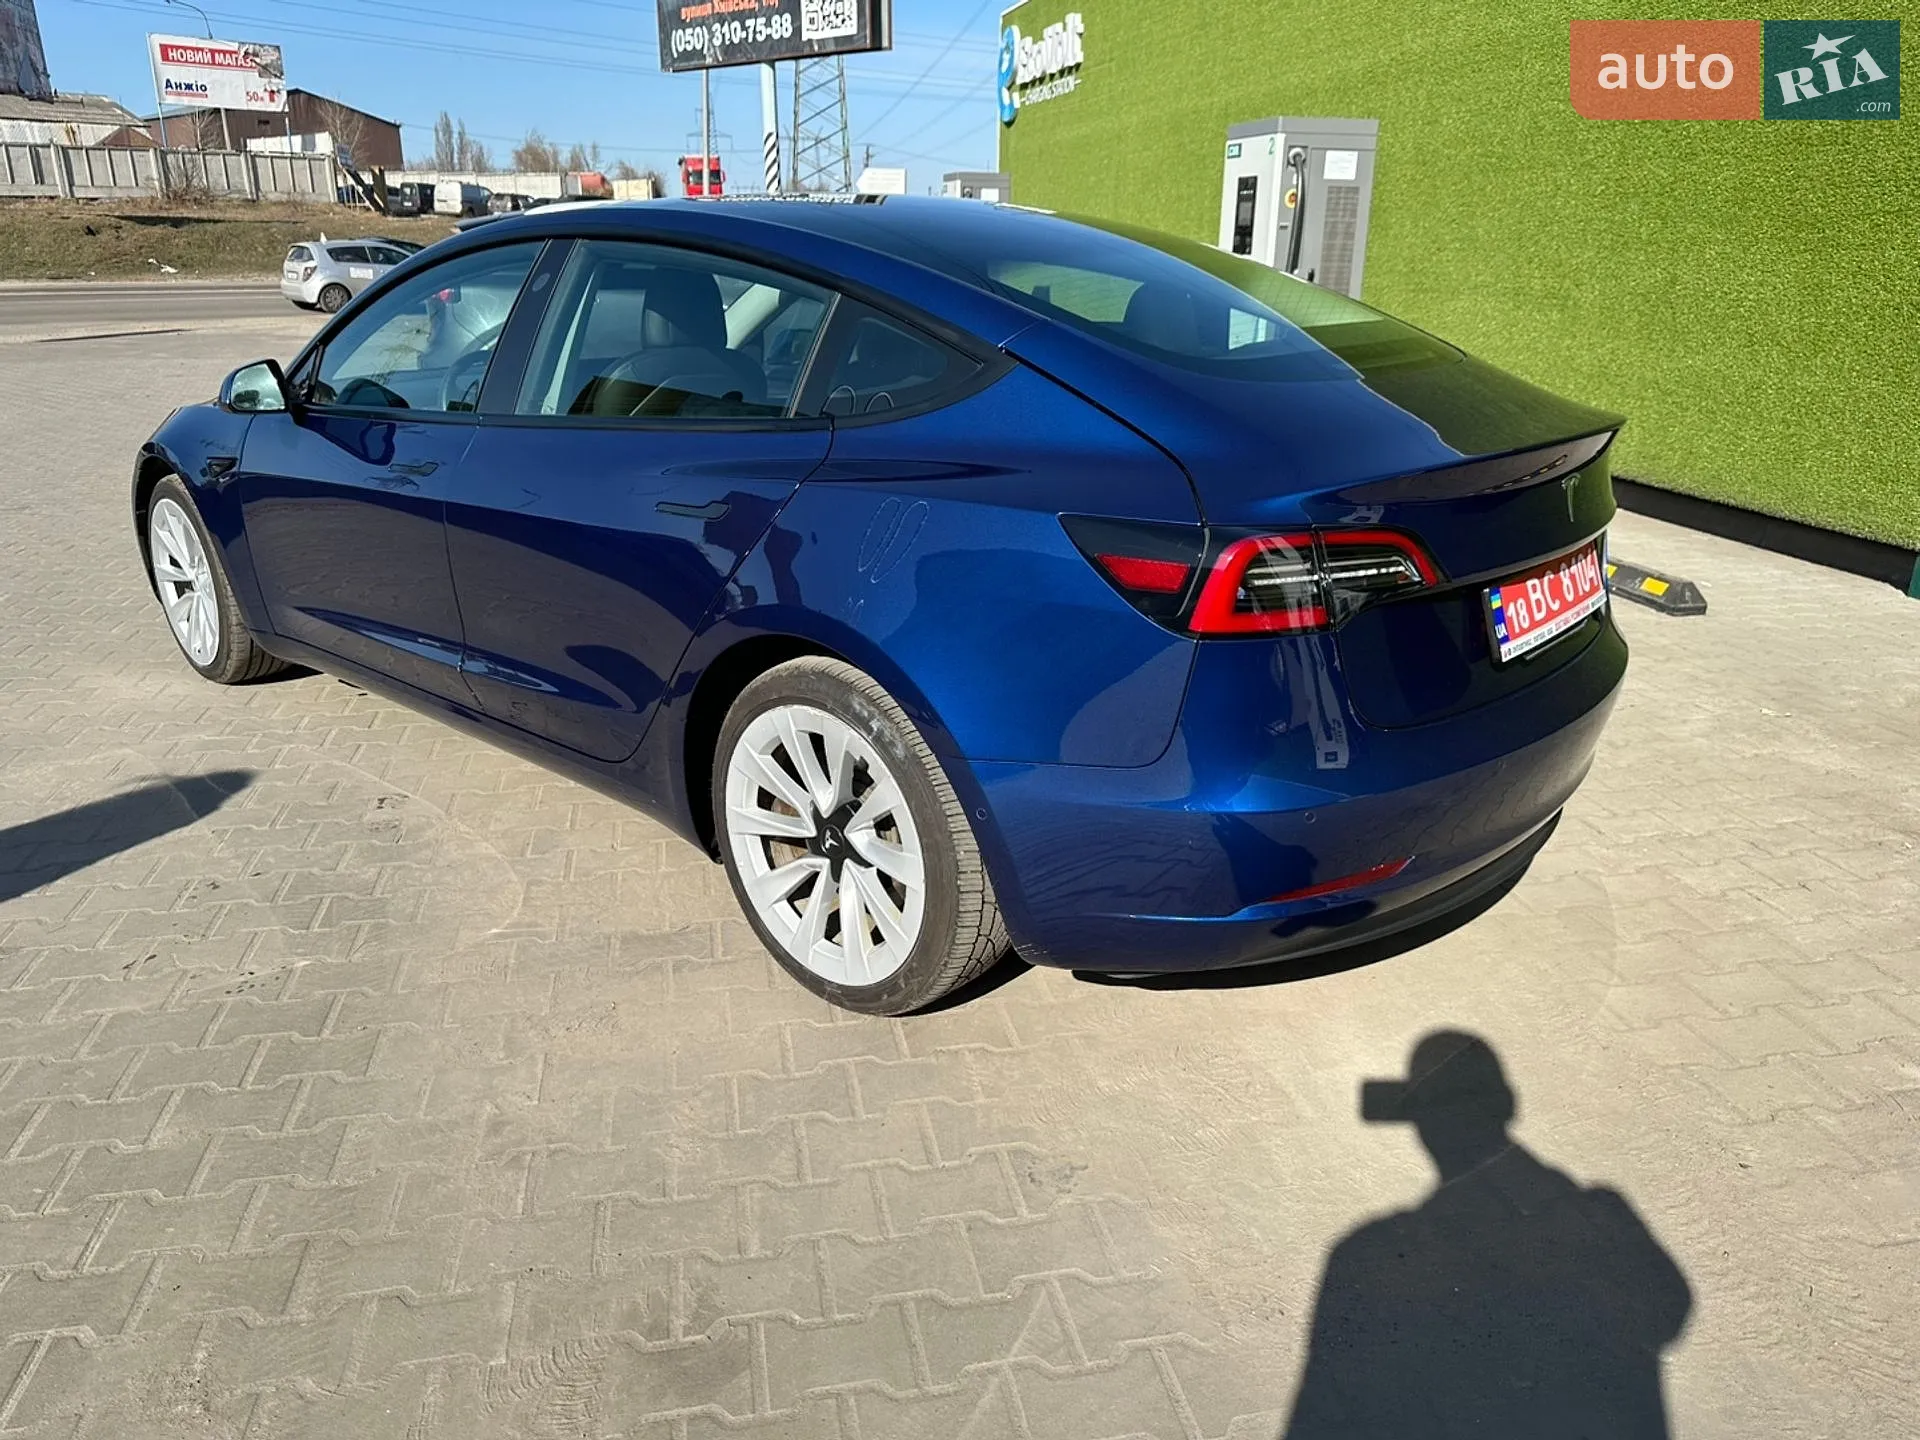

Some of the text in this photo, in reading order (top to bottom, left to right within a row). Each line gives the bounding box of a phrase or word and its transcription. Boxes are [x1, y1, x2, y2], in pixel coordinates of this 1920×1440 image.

[671, 13, 793, 58] (050) 310-75-88
[168, 47, 213, 64] НОВИЙ
[215, 53, 256, 67] МАГАЗ
[165, 78, 208, 93] Анжіо
[1268, 137, 1276, 155] 2
[1507, 598, 1530, 634] 18
[1526, 571, 1561, 622] BC
